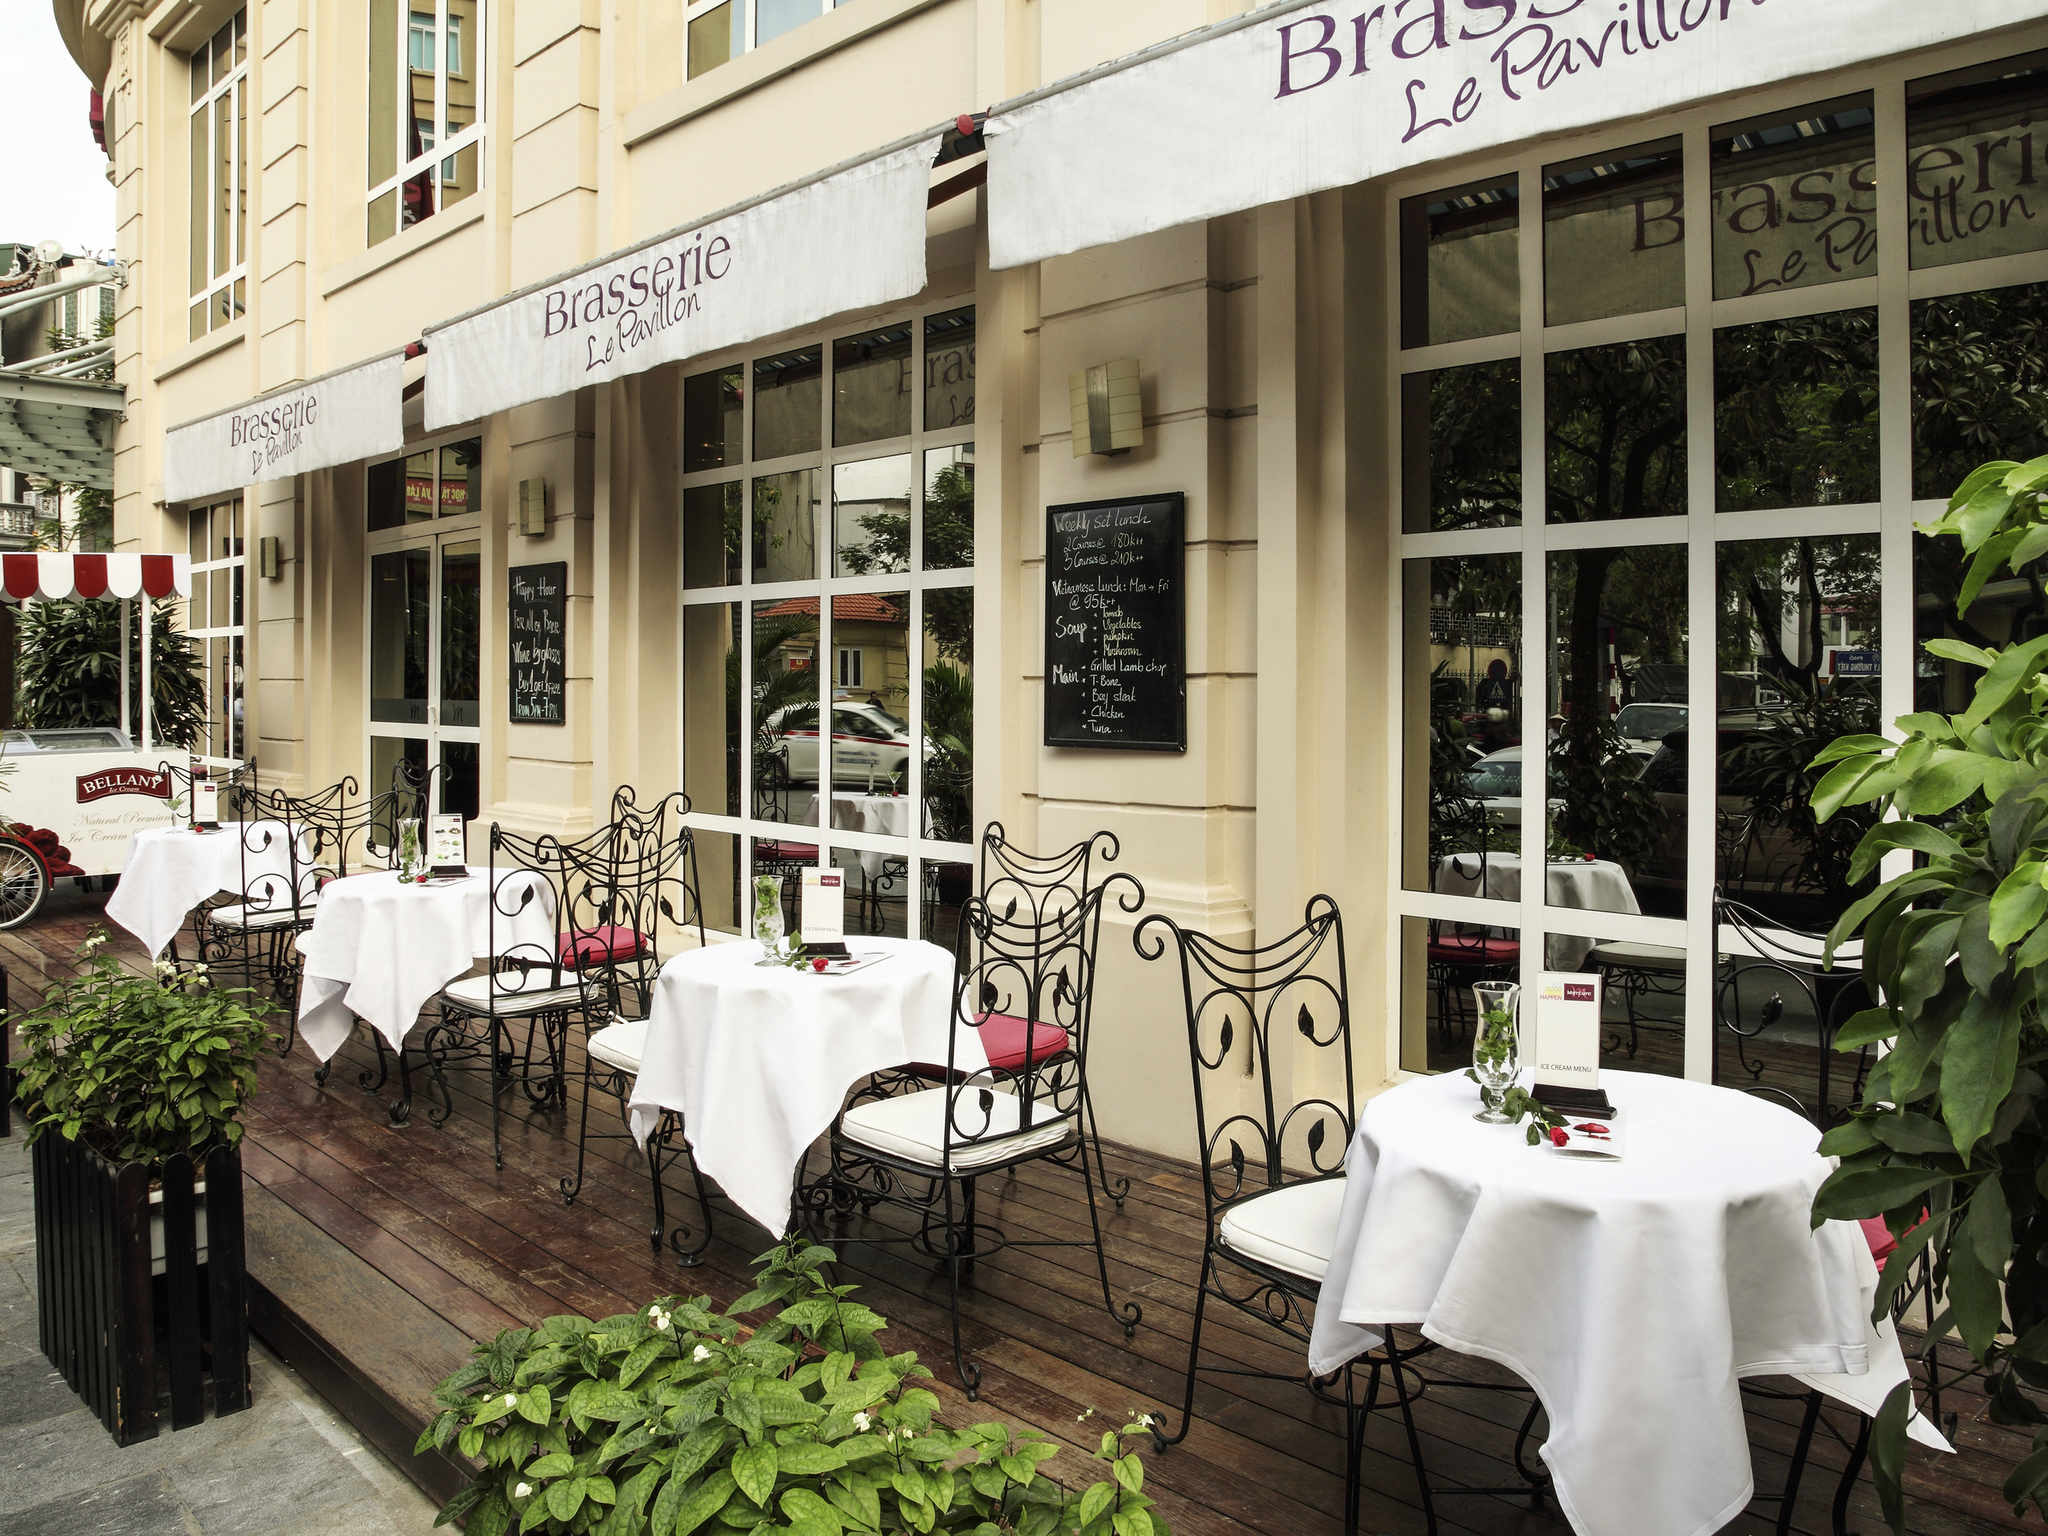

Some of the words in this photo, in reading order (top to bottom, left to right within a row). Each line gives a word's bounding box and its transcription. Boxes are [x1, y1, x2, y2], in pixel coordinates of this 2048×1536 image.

[1402, 77, 1482, 143] Le
[544, 233, 732, 339] Brasserie
[1742, 249, 1807, 296] Le
[586, 335, 614, 372] Le
[616, 277, 702, 352] Pavillon
[231, 392, 317, 447] Brasserie
[265, 419, 303, 466] Pavillon
[1052, 511, 1091, 538] Weekly
[512, 575, 535, 601] Happy
[537, 575, 557, 597] Hour
[1055, 616, 1088, 643] Soup
[1052, 664, 1079, 685] Main
[1090, 658, 1116, 672] Grilled
[1119, 658, 1144, 672] Lamb
[1090, 705, 1126, 719] Chicken
[83, 774, 164, 794] BELLANY
[1573, 1065, 1592, 1073] MENU
